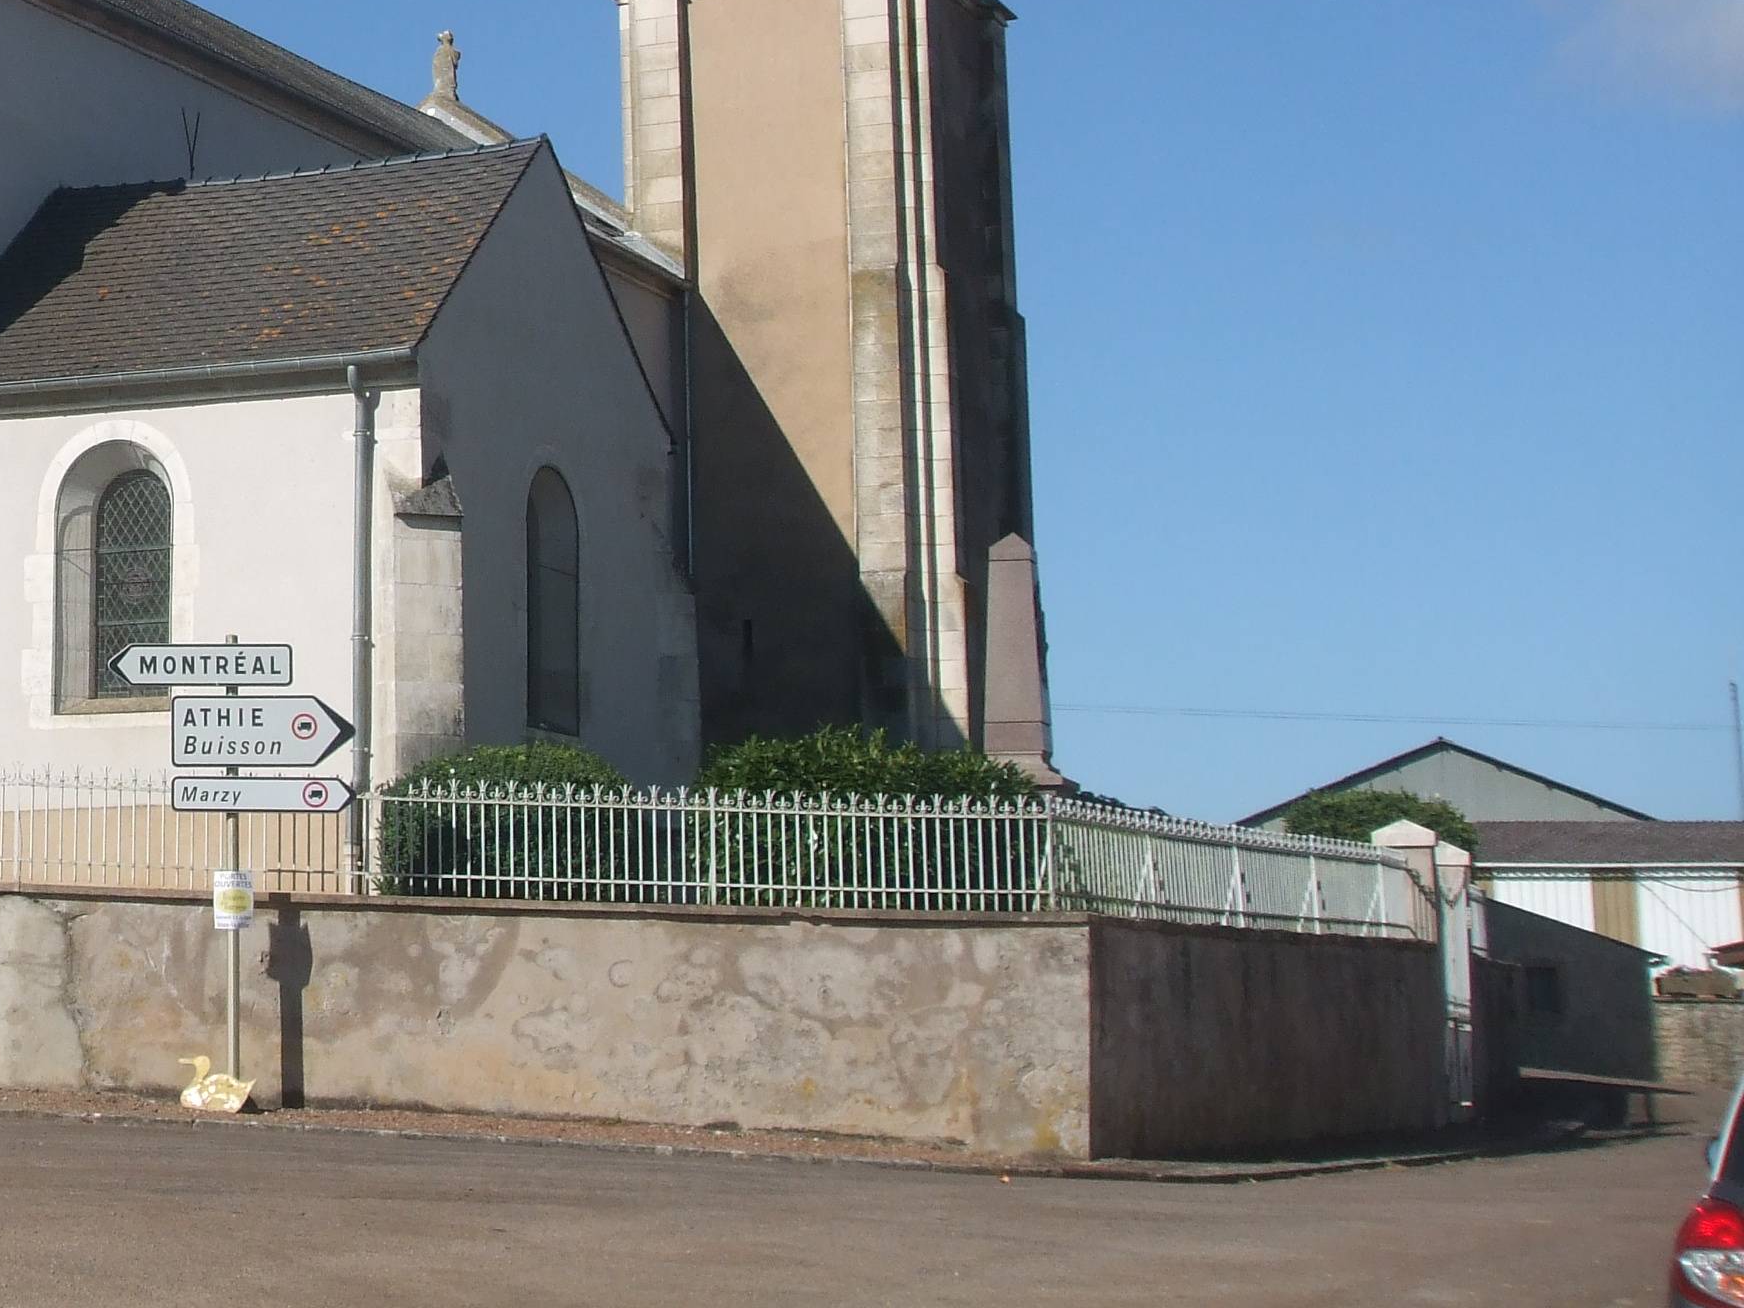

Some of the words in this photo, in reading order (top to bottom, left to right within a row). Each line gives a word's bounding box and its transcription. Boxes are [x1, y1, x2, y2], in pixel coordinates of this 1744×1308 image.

[138, 651, 283, 676] MONTRÉAL
[182, 707, 265, 728] ATHIE
[183, 735, 282, 756] Buisson
[180, 786, 242, 806] Marzy
[214, 881, 252, 889] OUVERTES
